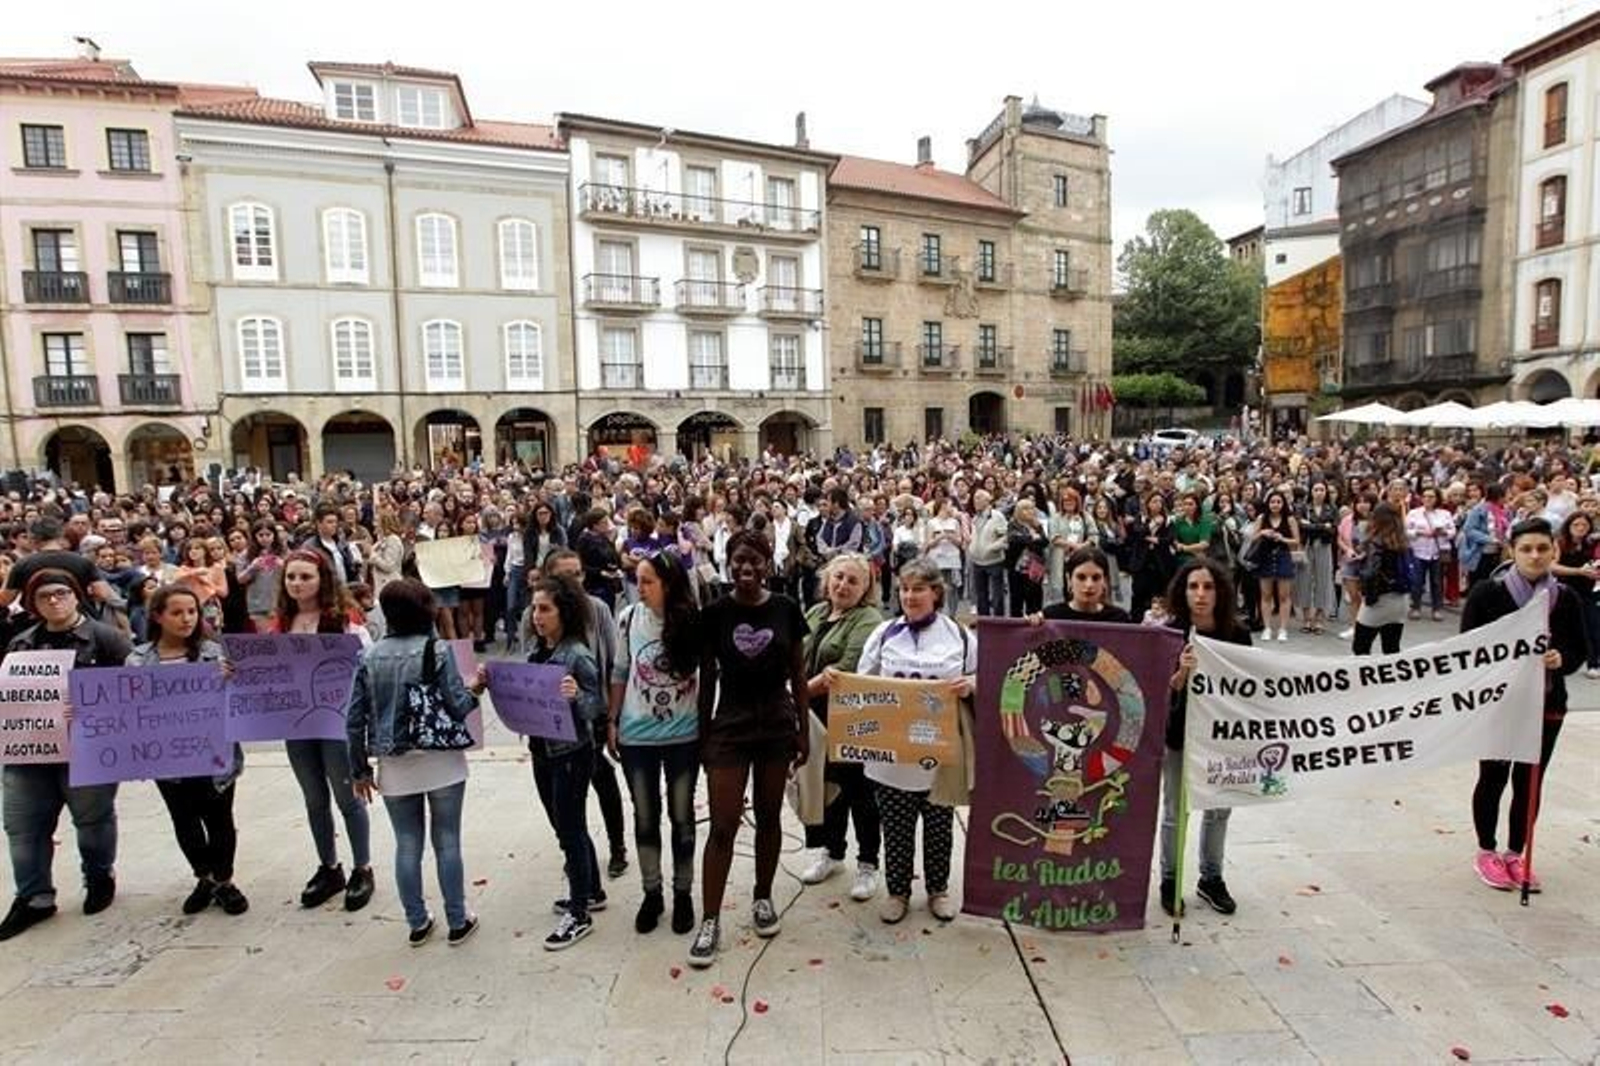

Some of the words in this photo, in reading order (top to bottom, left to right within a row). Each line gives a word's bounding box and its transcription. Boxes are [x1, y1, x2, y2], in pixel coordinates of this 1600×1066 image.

[9, 664, 60, 676] MANADA
[1191, 673, 1213, 695] SI
[1220, 677, 1257, 698] NO
[1264, 669, 1350, 698] SOMOS
[1359, 634, 1547, 686] RESPETADAS
[0, 688, 60, 702] LIBERADA
[79, 682, 109, 706] LA
[1211, 716, 1336, 740] HAREMOS
[1347, 706, 1404, 734] QUE
[1409, 697, 1442, 719] SE
[1452, 683, 1507, 711] NOS
[2, 718, 54, 731] JUSTICIA
[4, 742, 59, 756] AGOTADA
[130, 740, 162, 762] NO
[841, 745, 895, 763] COLONIAL
[1291, 740, 1414, 772] RESPETE
